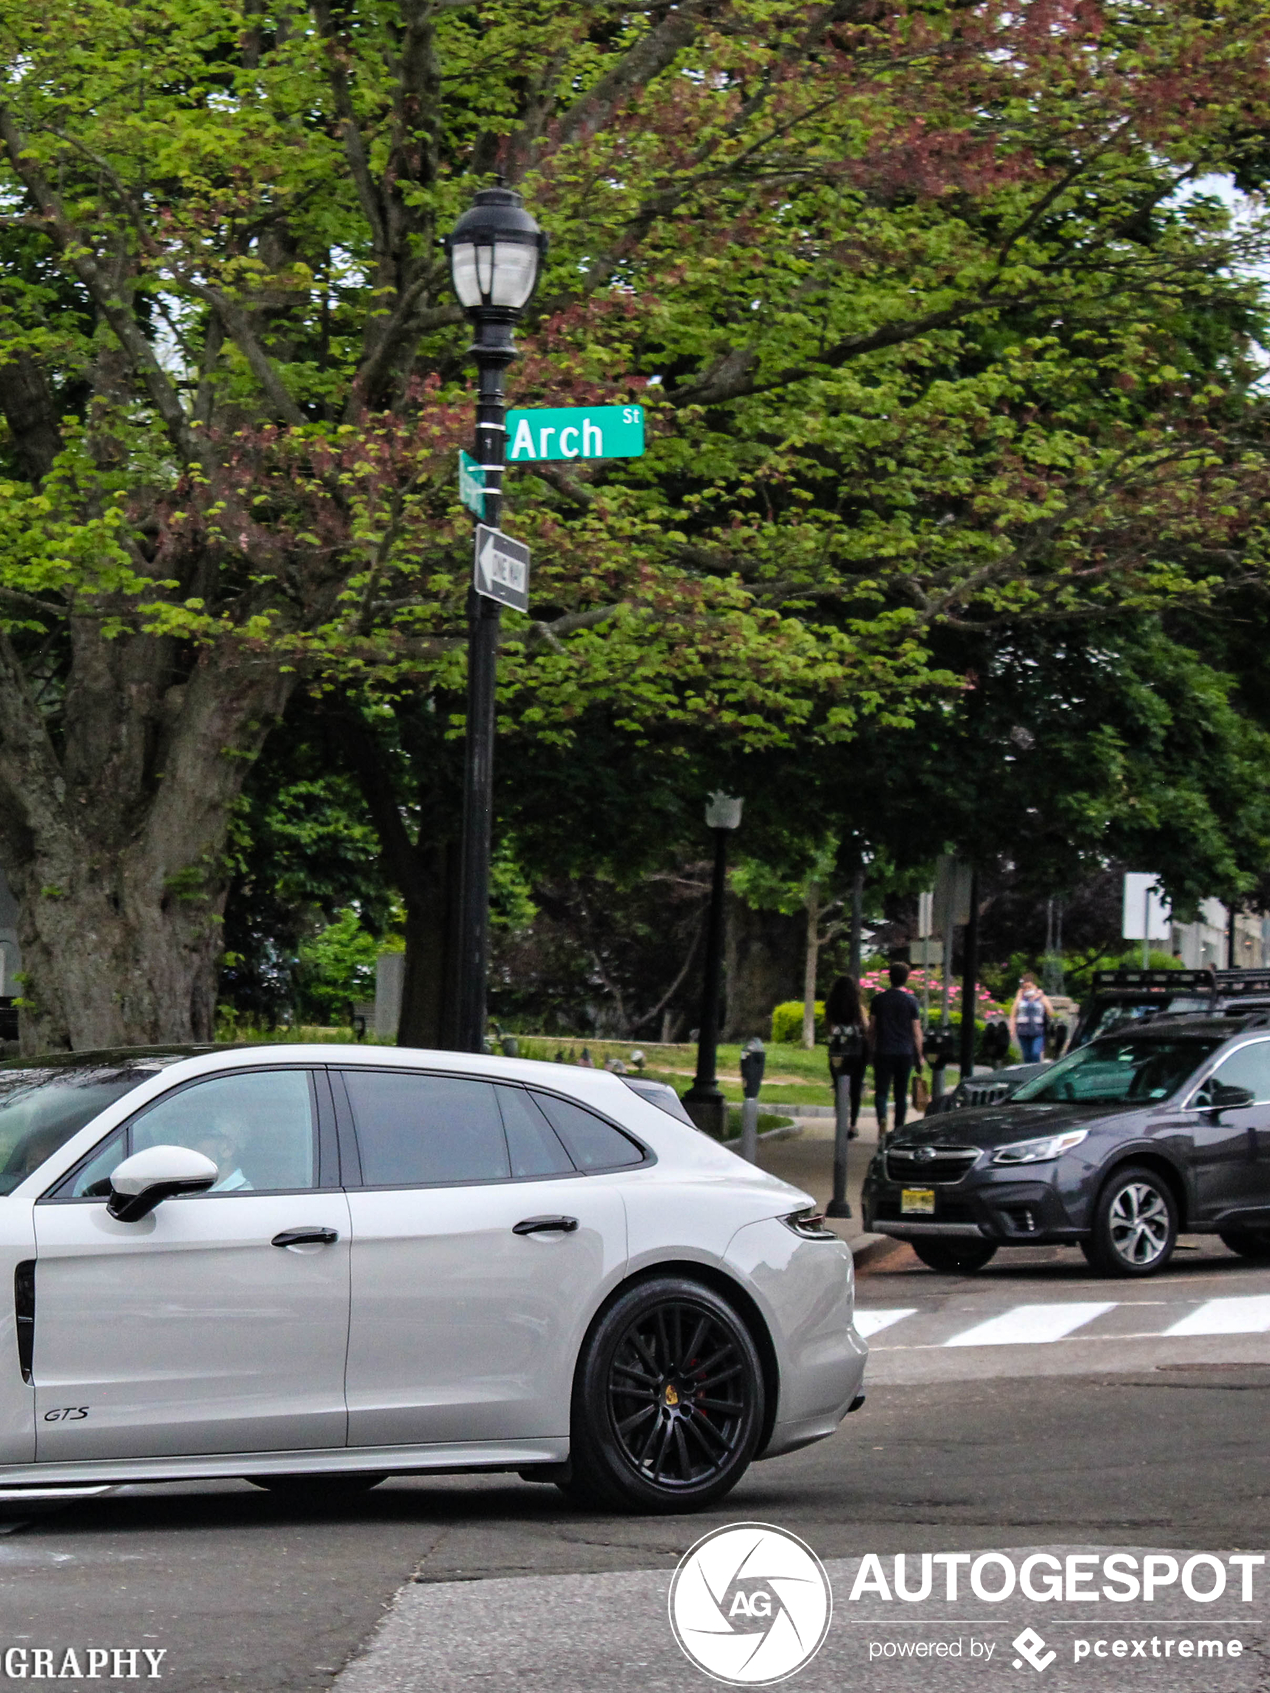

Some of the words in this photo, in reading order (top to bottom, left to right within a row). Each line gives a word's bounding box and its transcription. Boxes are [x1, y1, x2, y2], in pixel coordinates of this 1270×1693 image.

[511, 418, 603, 459] Arch
[622, 408, 640, 424] St
[44, 1406, 90, 1422] GTS
